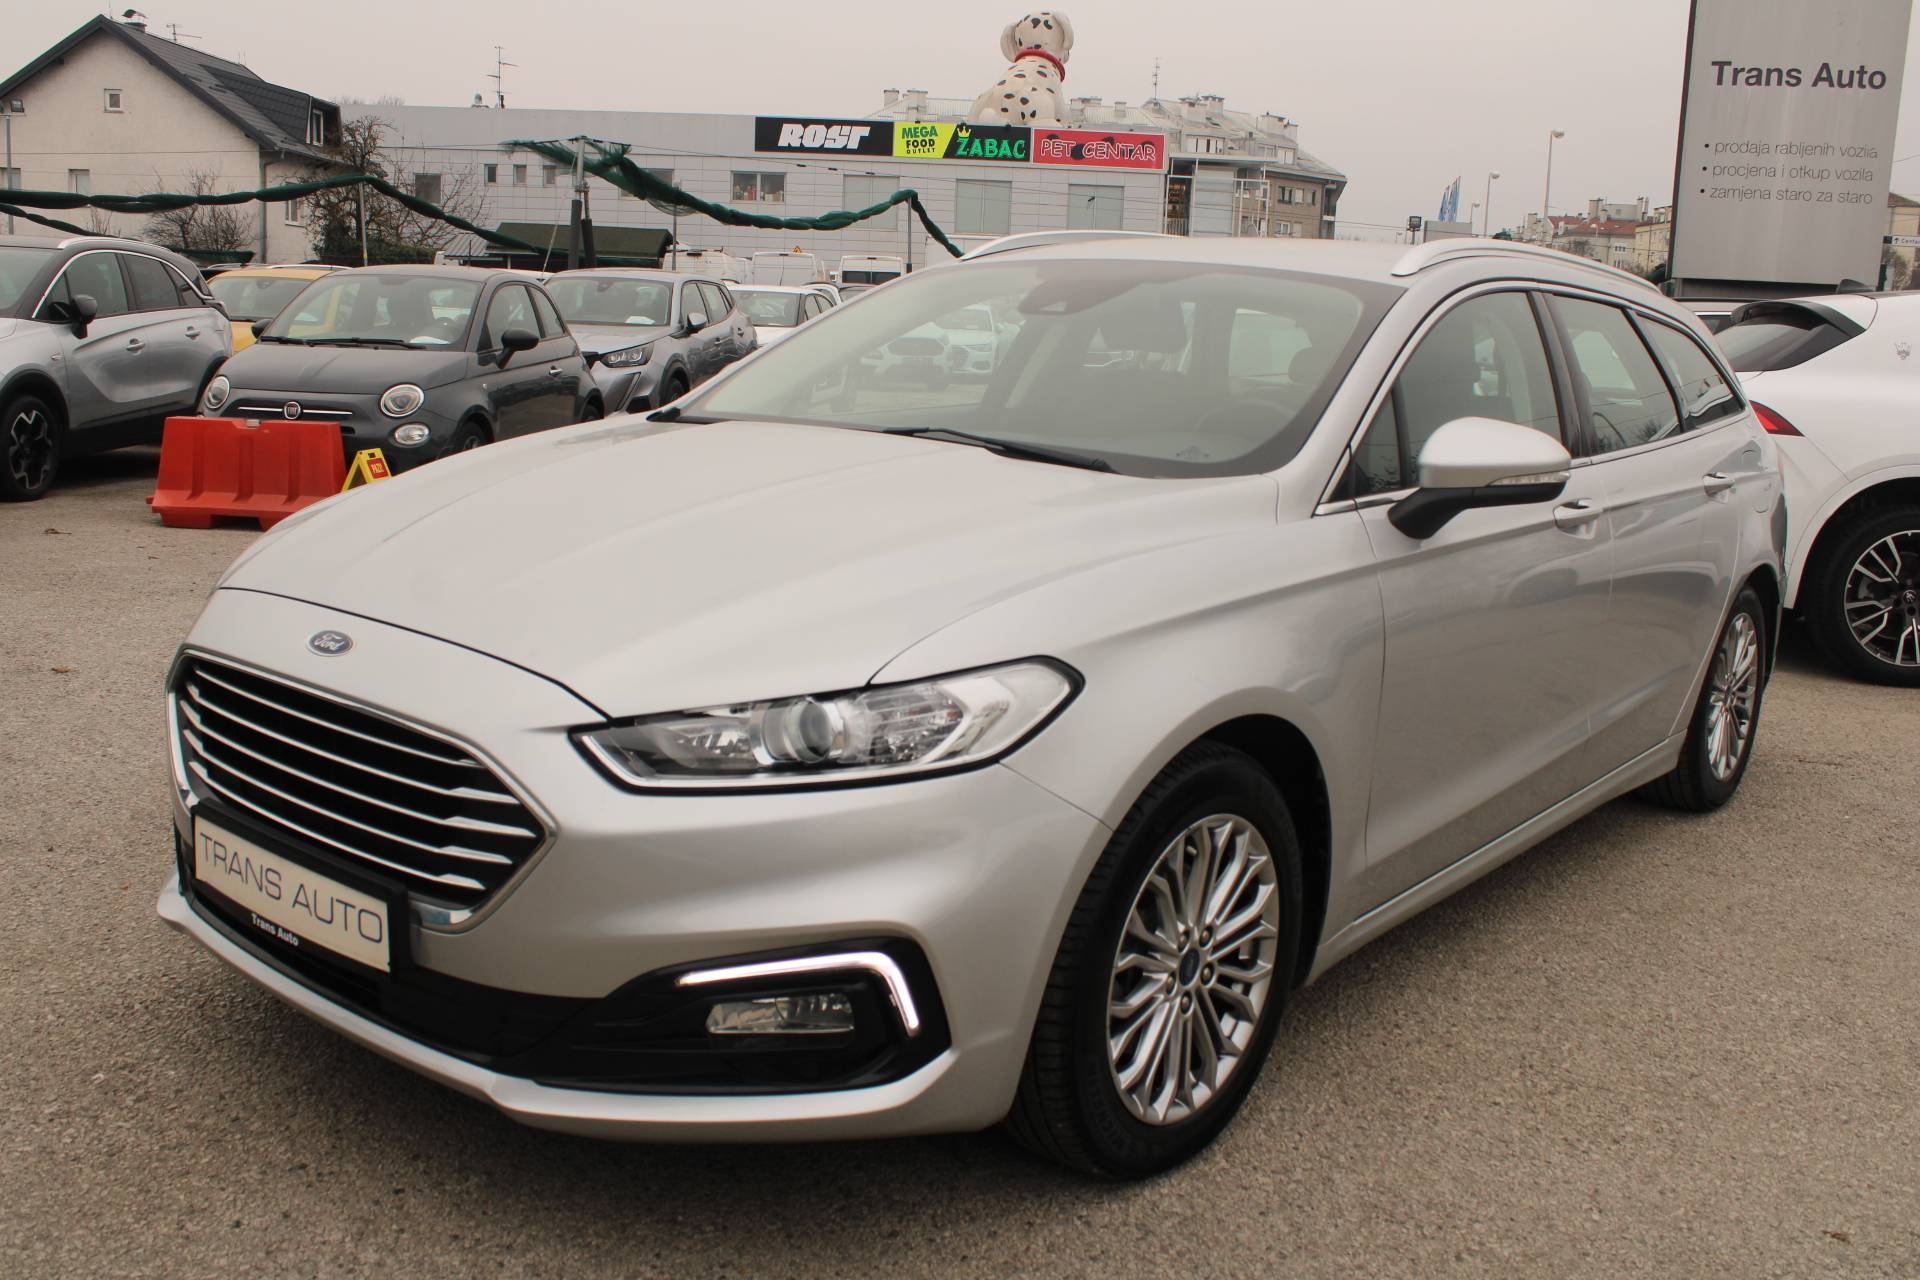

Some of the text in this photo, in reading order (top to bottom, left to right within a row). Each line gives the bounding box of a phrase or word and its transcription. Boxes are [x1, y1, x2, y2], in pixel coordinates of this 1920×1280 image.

[1711, 60, 1887, 90] Trans Auto
[778, 123, 871, 149] ROST
[902, 126, 938, 139] MEGA
[906, 139, 935, 148] FOOD
[1041, 138, 1155, 161] PET CENTAR
[1714, 140, 1878, 159] prodaja rabljenih vozila
[1712, 163, 1776, 180] procjena
[1789, 165, 1830, 182] otkup
[1835, 168, 1873, 182] vozila
[1710, 186, 1873, 204] zamjena staro za staro
[200, 832, 383, 944] TRANS AUTO
[251, 912, 299, 947] Trans Auto
